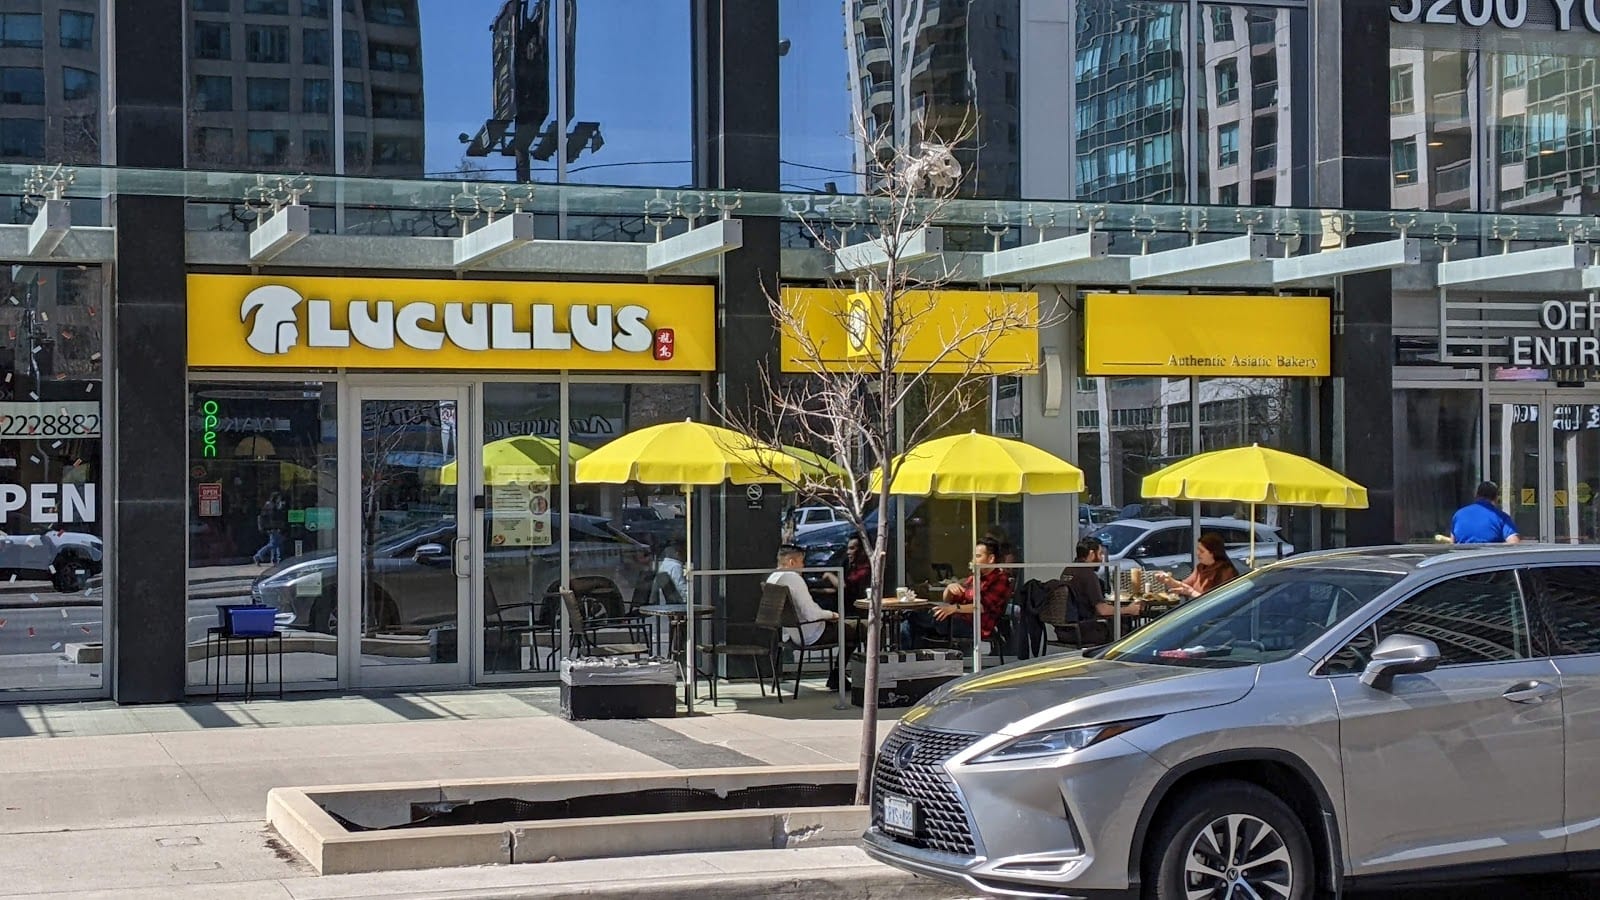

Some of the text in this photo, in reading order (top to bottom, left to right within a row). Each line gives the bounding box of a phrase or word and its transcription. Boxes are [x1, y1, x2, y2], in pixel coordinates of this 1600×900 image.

[308, 299, 653, 352] LUCULLUS
[1168, 355, 1318, 368] Authentic Asiatic Bakery
[1513, 336, 1600, 366] ENTR
[0, 414, 100, 436] 2228882
